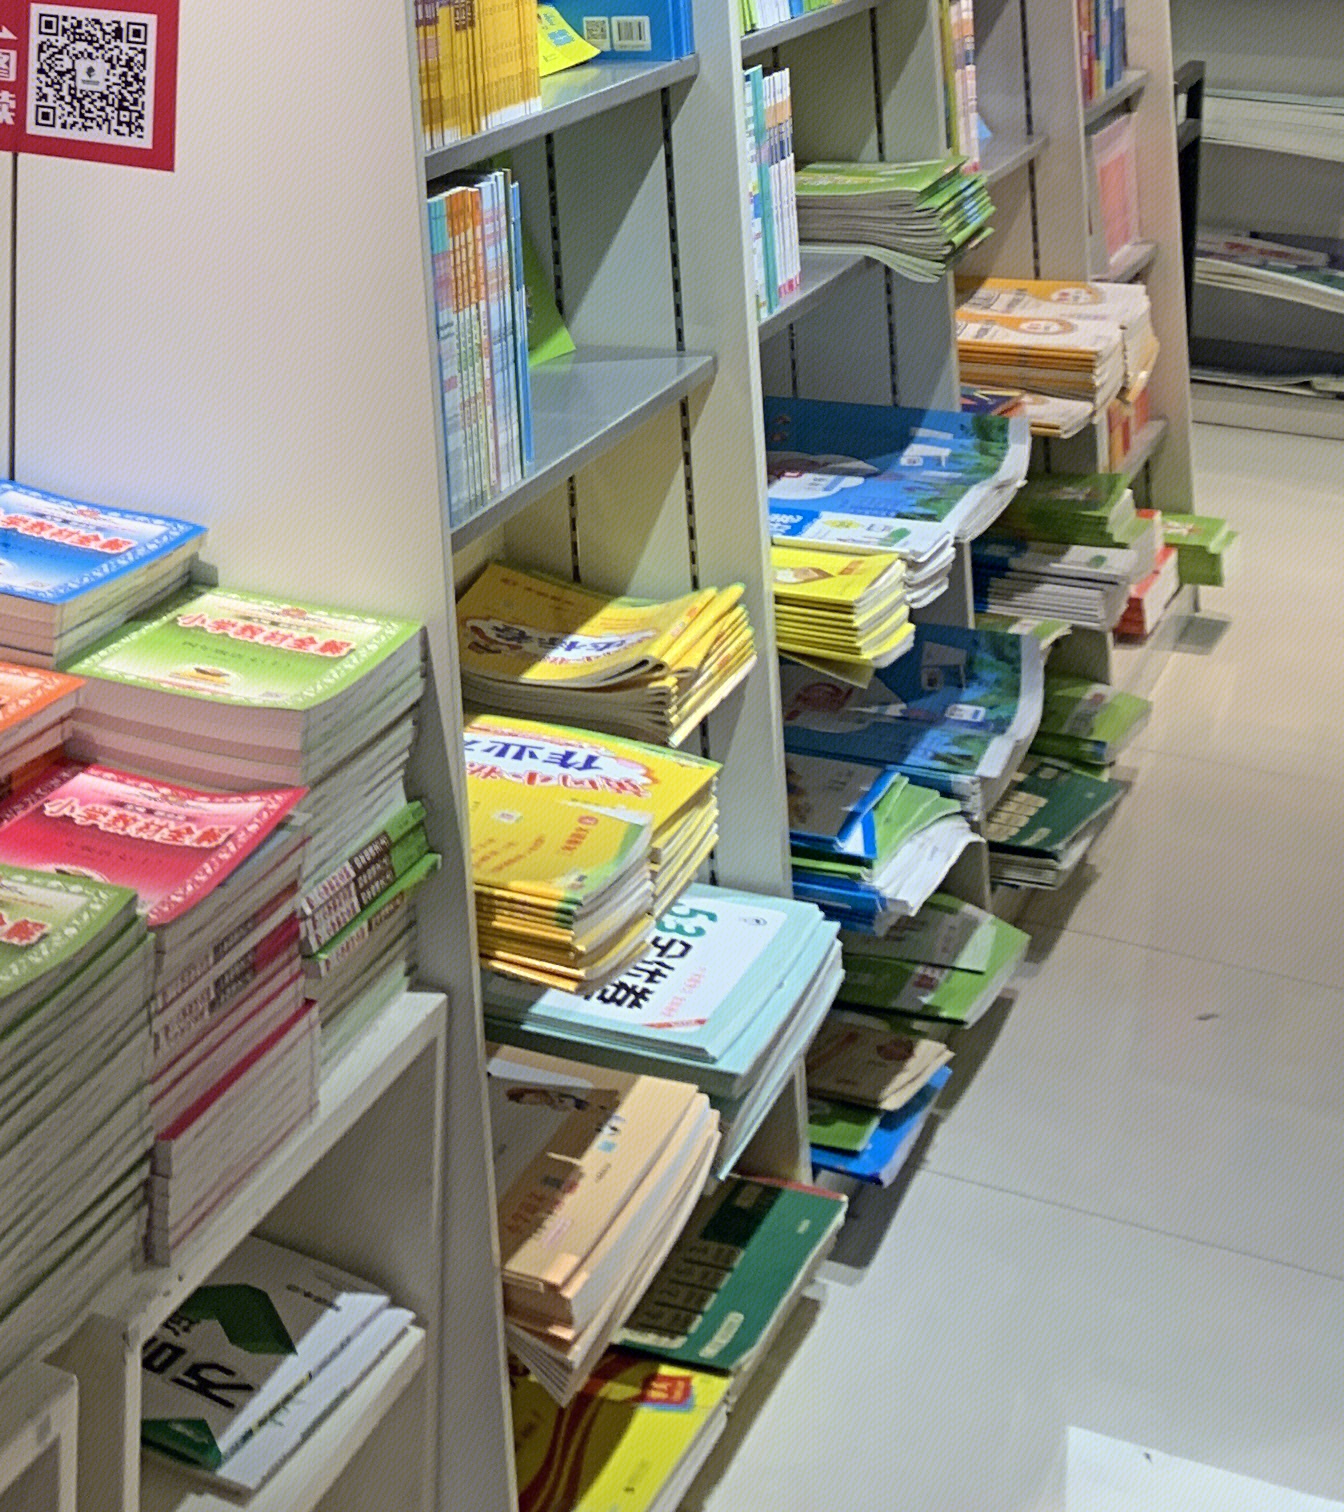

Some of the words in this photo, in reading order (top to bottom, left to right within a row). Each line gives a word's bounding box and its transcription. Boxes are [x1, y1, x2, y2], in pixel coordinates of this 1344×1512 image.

[177, 613, 356, 657] 小学教材全解
[44, 797, 236, 848] 小学教材全解
